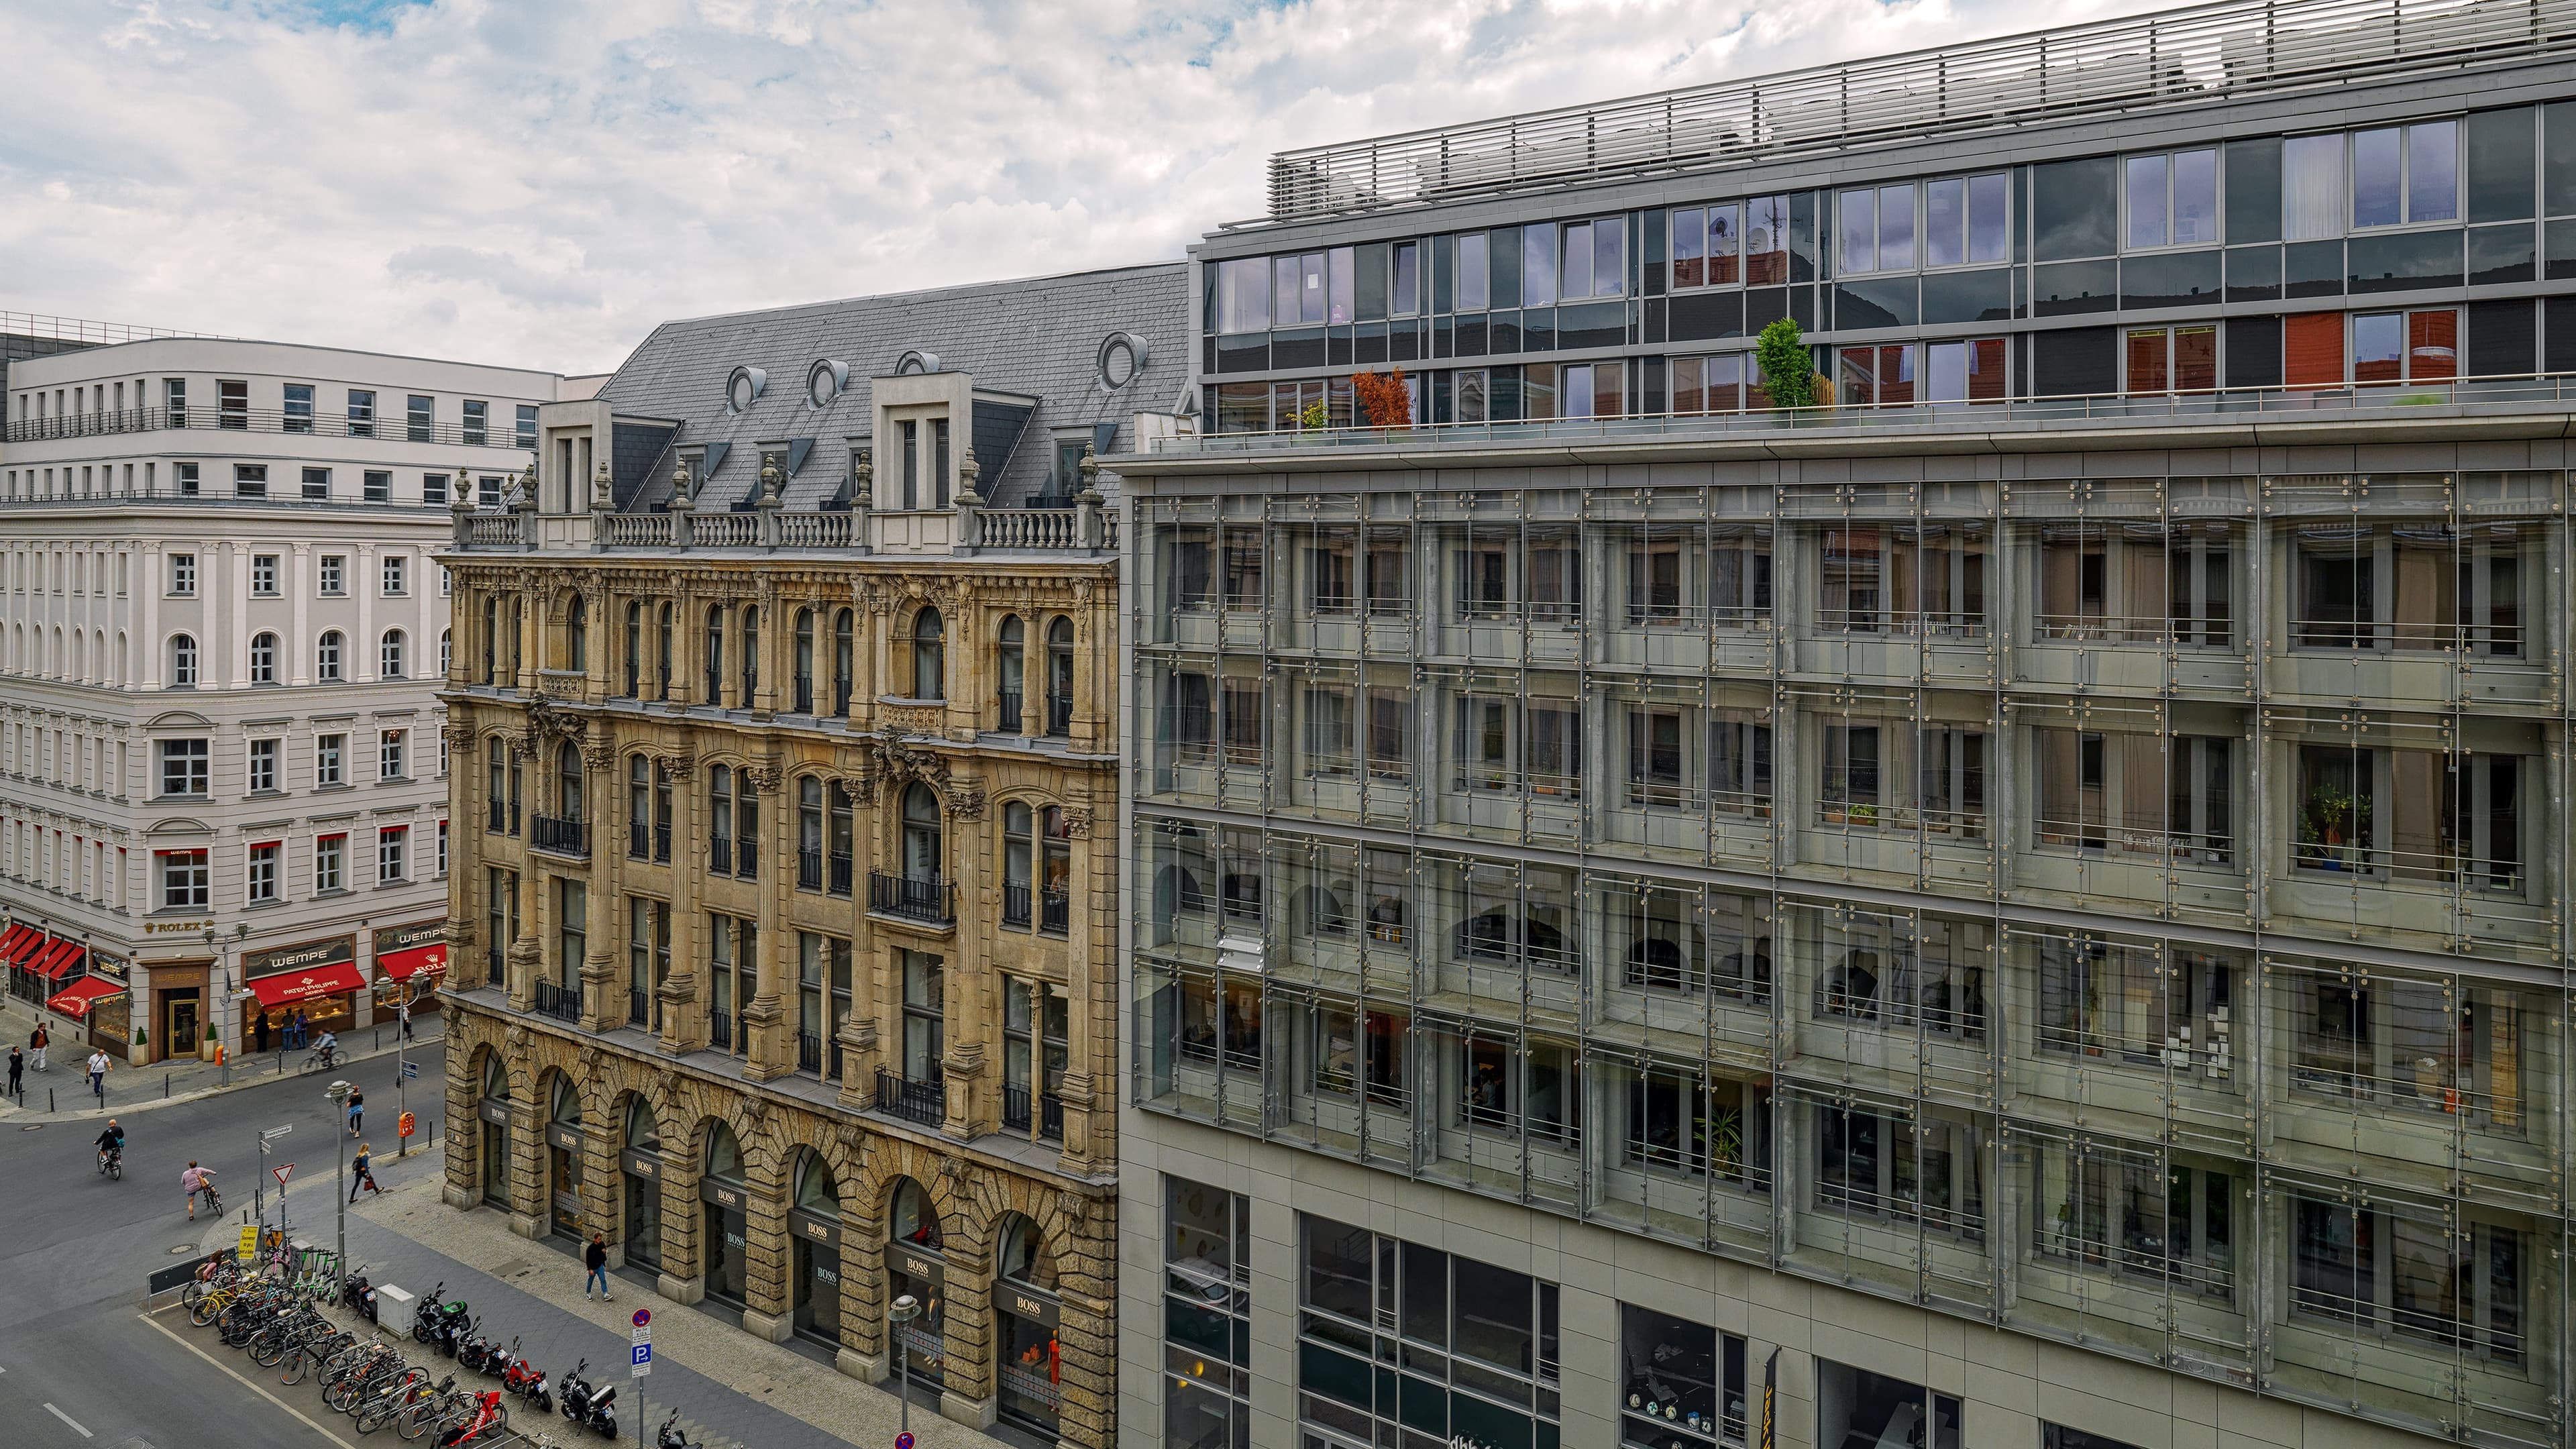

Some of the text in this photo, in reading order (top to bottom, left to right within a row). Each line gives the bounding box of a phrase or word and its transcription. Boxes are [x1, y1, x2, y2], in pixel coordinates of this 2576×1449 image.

[158, 922, 201, 932] ROLEX
[272, 950, 327, 967] WEMPE
[100, 961, 121, 975] WEMPE
[415, 961, 447, 972] ROLE
[156, 973, 201, 983] WEMPE
[283, 980, 339, 996] PATEK PHILIPPE
[95, 994, 125, 1004] WEMPE
[492, 1108, 505, 1120] BOSS
[561, 1133, 576, 1146] BOSS
[637, 1160, 653, 1173] BOSS
[718, 1189, 735, 1203] BOSS
[808, 1222, 827, 1238] BOSS
[727, 1232, 745, 1248] BOSS
[907, 1257, 928, 1274] BOSS
[818, 1267, 837, 1283] BOSS
[1017, 1296, 1040, 1314] BOSS
[636, 1347, 647, 1362] P
[1763, 1385, 1772, 1439] Jack
[474, 1411, 486, 1429] JUMP
